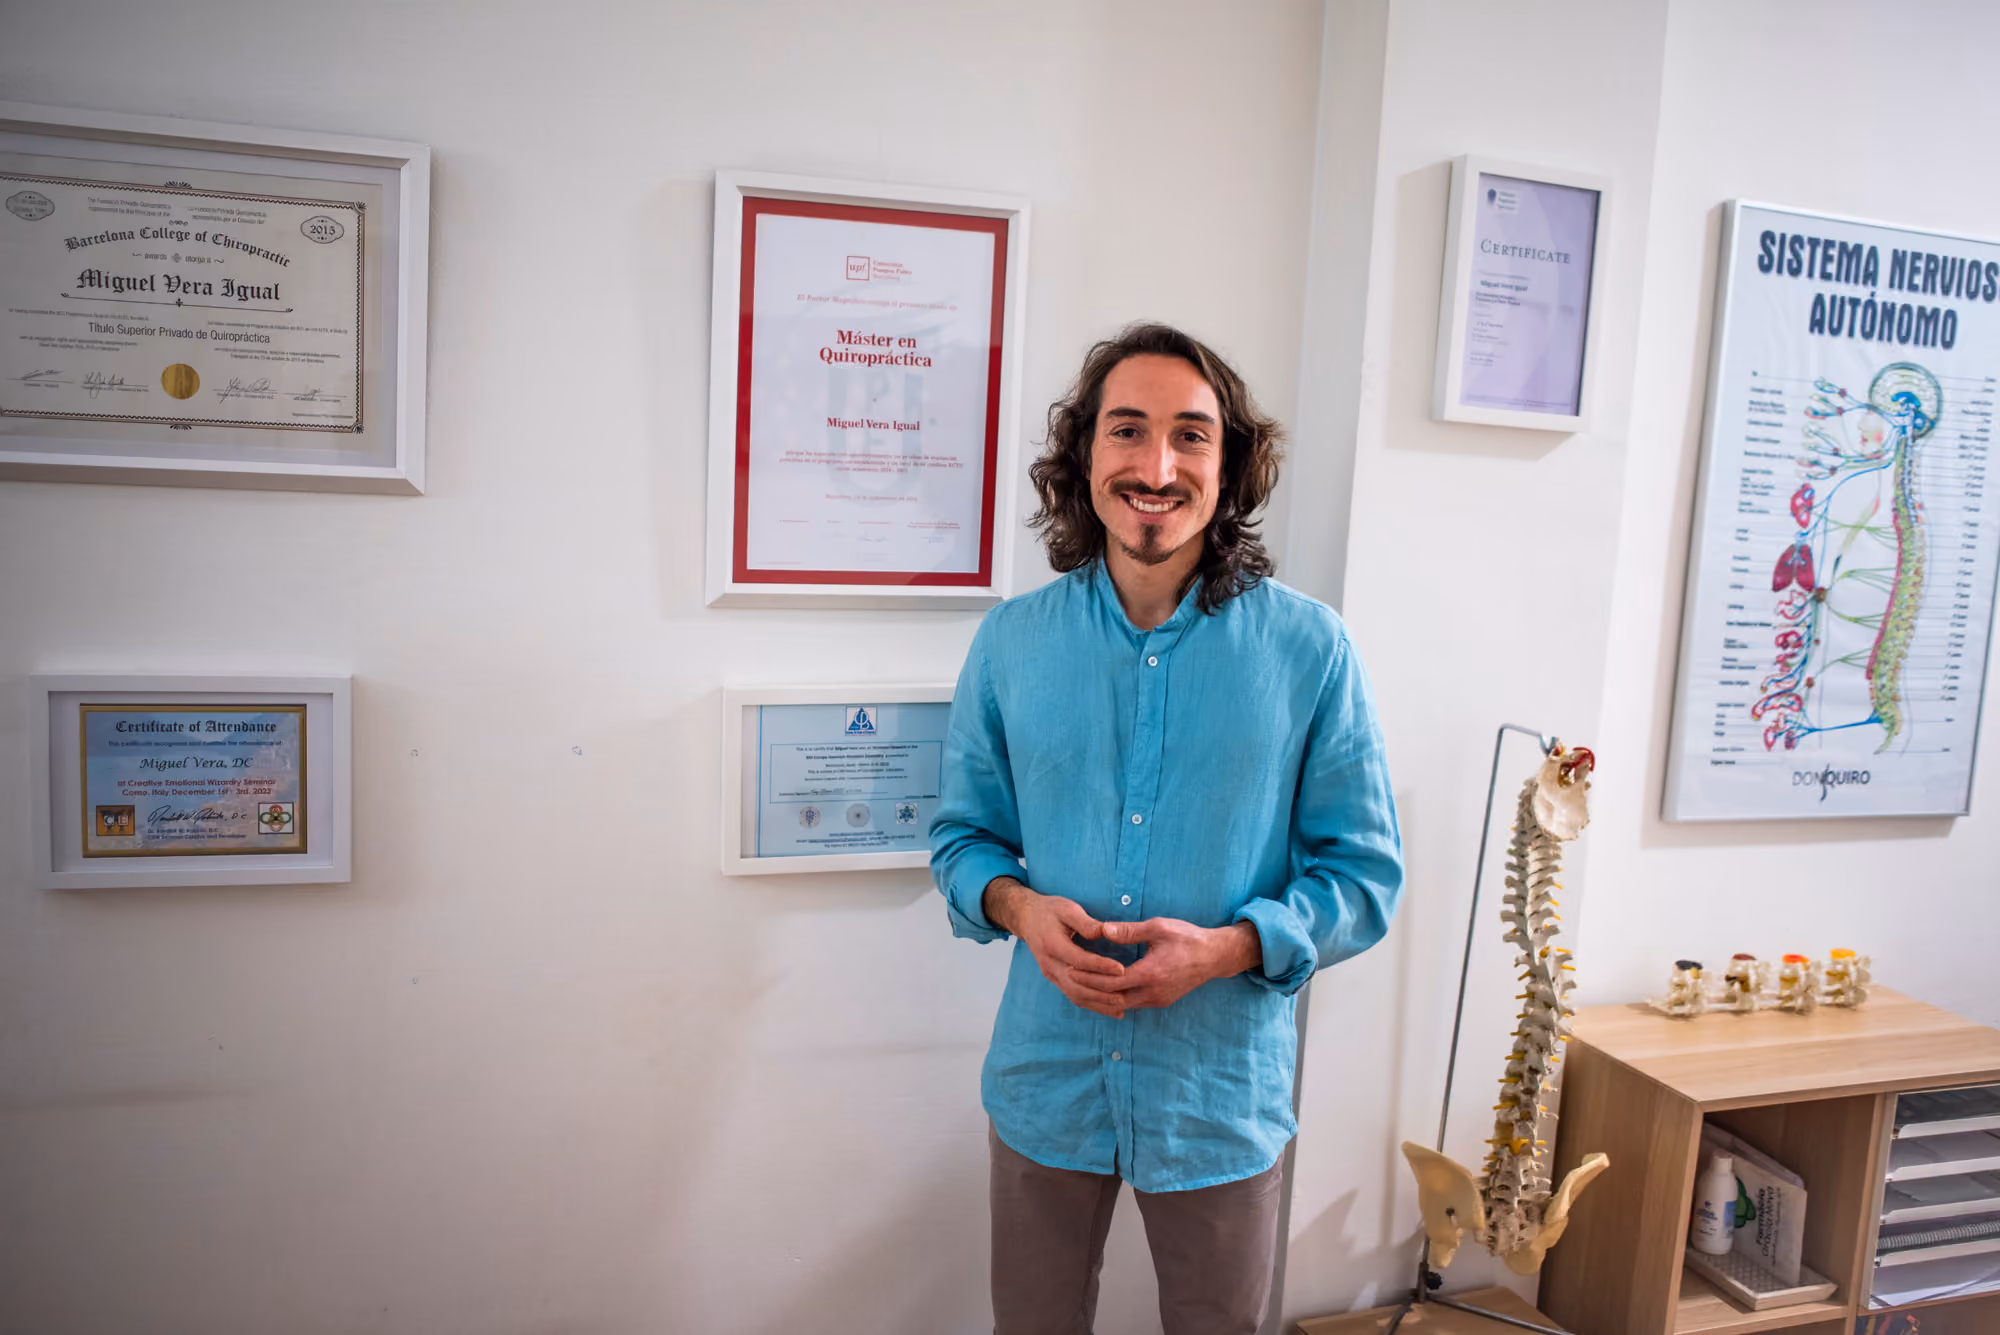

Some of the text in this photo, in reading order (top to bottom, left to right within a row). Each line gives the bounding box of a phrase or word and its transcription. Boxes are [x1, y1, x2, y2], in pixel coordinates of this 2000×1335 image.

[64, 226, 291, 268] Barcelona College of Chiropractic
[1758, 230, 2000, 302] SISTEMA NERVIOS
[77, 268, 280, 302] Miguel Vera Igual
[1809, 291, 1958, 350] AUTÓNOMO
[117, 324, 156, 337] Superior
[159, 327, 193, 340] Privado
[196, 330, 208, 340] de
[211, 330, 271, 345] Quiropráctica
[836, 329, 917, 349] Máster en
[820, 346, 932, 368] Quiropráctica
[827, 416, 921, 432] Miguel Vera Igual
[116, 720, 277, 733] Certificate of Attendance
[139, 757, 190, 772] Miguel
[231, 758, 253, 768] DC
[117, 778, 275, 788] at Creative Emotional Wizardry Seminar
[152, 788, 169, 797] Italy
[172, 788, 215, 796] December
